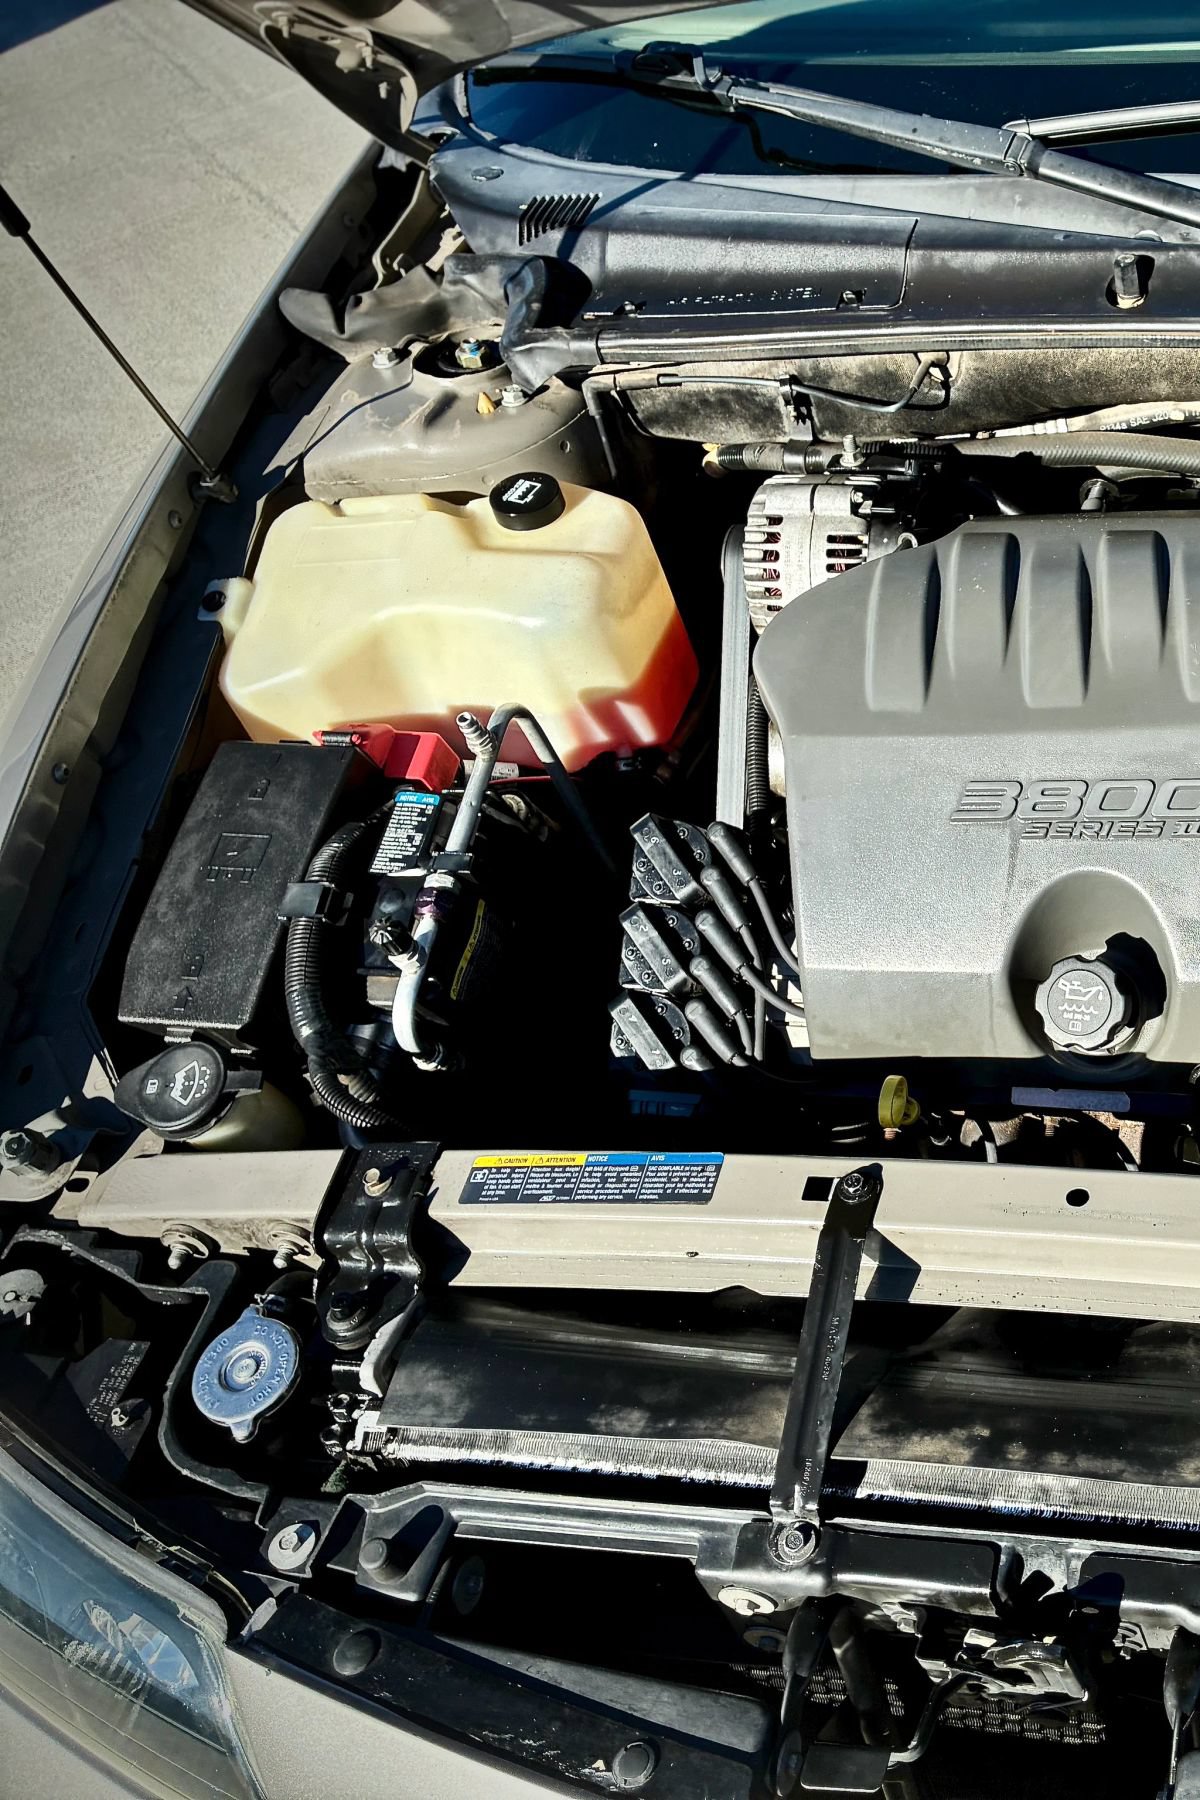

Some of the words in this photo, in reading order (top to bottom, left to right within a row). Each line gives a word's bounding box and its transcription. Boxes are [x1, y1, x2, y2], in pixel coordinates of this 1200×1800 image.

[1129, 416, 1150, 427] SAE
[1020, 820, 1167, 840] SERIES
[270, 1329, 289, 1349] NOT
[247, 1384, 273, 1409] HOT
